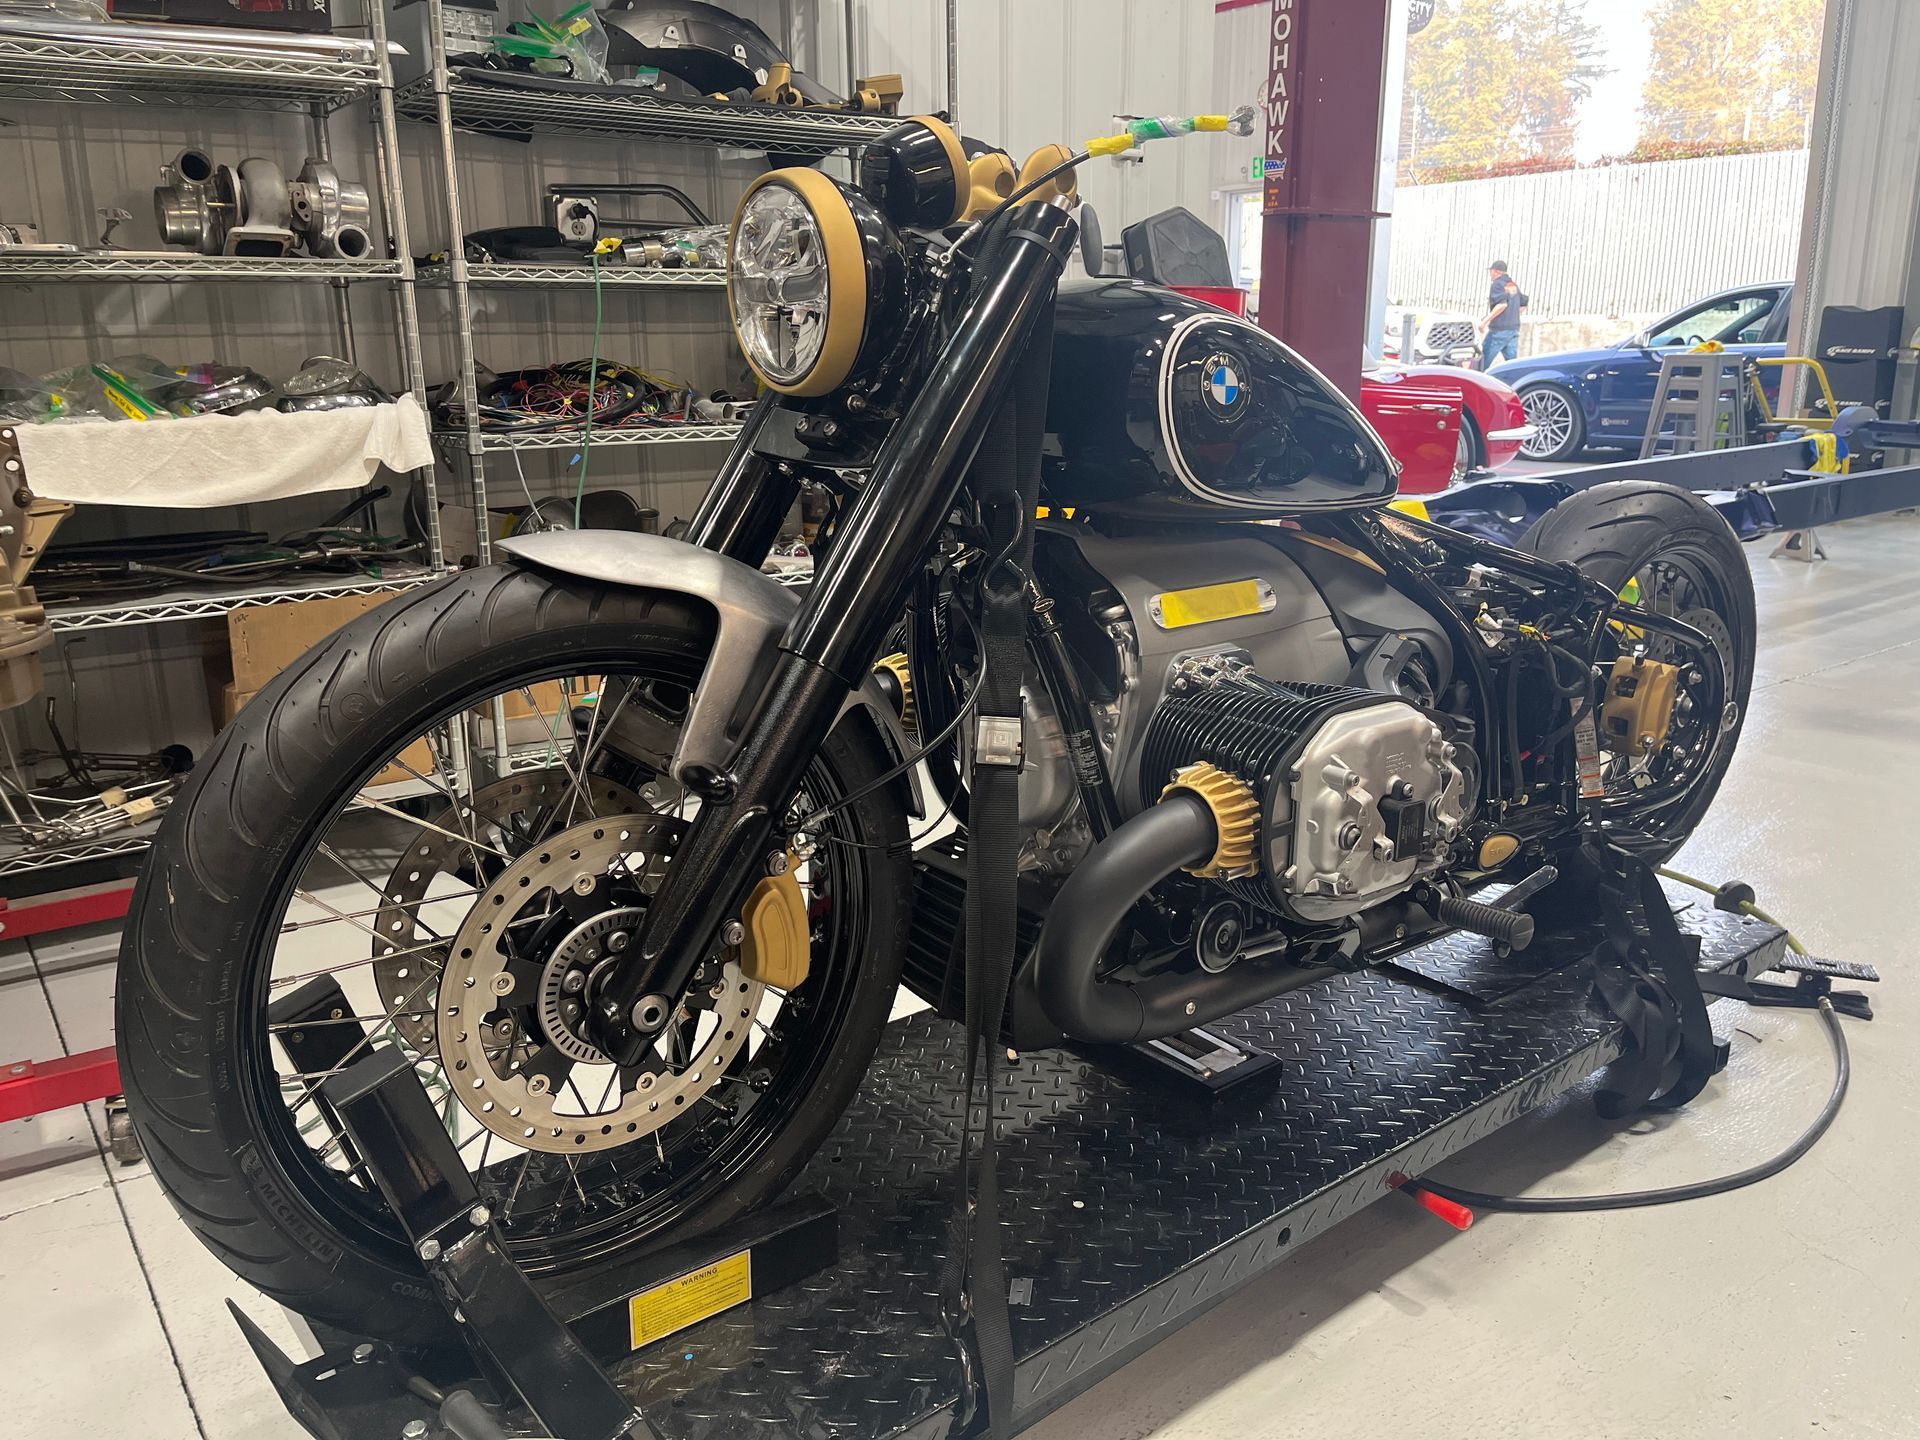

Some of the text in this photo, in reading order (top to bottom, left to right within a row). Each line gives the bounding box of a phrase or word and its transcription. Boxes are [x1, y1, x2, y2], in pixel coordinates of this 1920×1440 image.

[1252, 156, 1265, 179] EX
[260, 1182, 336, 1257] MICHELIN
[680, 1267, 719, 1287] WARNING
